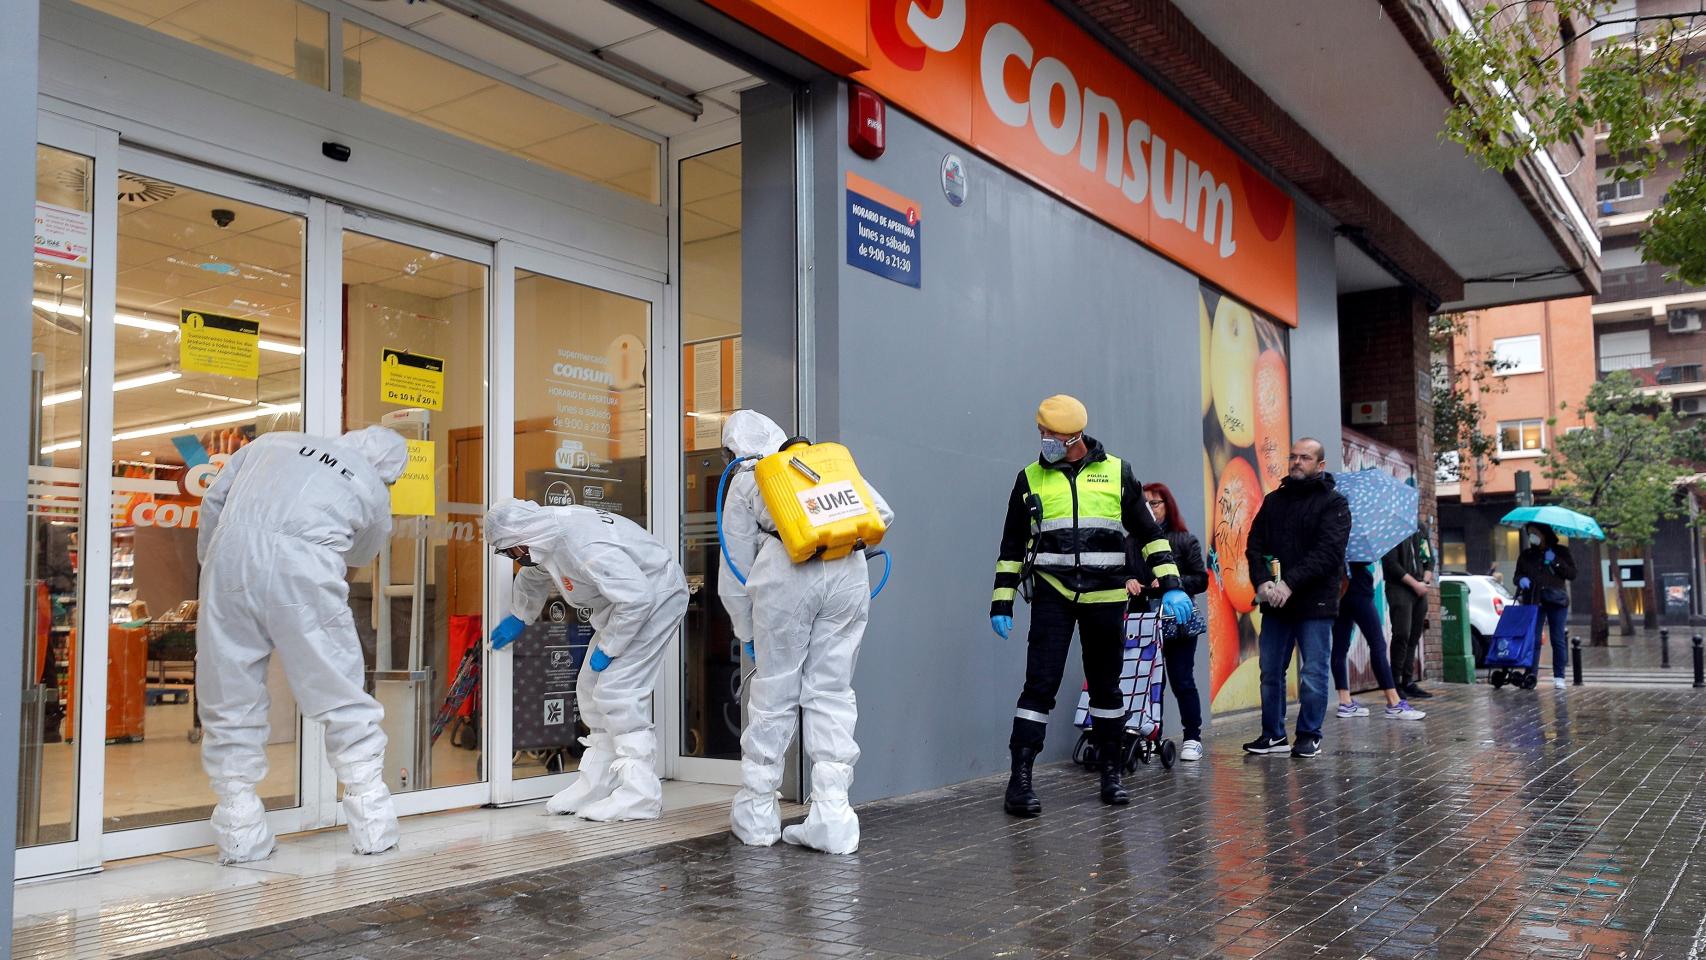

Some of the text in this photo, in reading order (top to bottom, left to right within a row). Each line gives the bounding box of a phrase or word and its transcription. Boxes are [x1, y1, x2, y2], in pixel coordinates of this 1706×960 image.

[980, 22, 1236, 258] consum
[852, 203, 916, 239] HORARIO DE APERTURA
[858, 221, 911, 255] lunes a sábado
[858, 243, 911, 273] de 9:00 a 21:30
[552, 363, 613, 386] consum
[552, 416, 564, 426] de
[298, 446, 355, 482] UME
[548, 494, 572, 505] verde
[817, 489, 859, 511] UME
[131, 502, 201, 528] con
